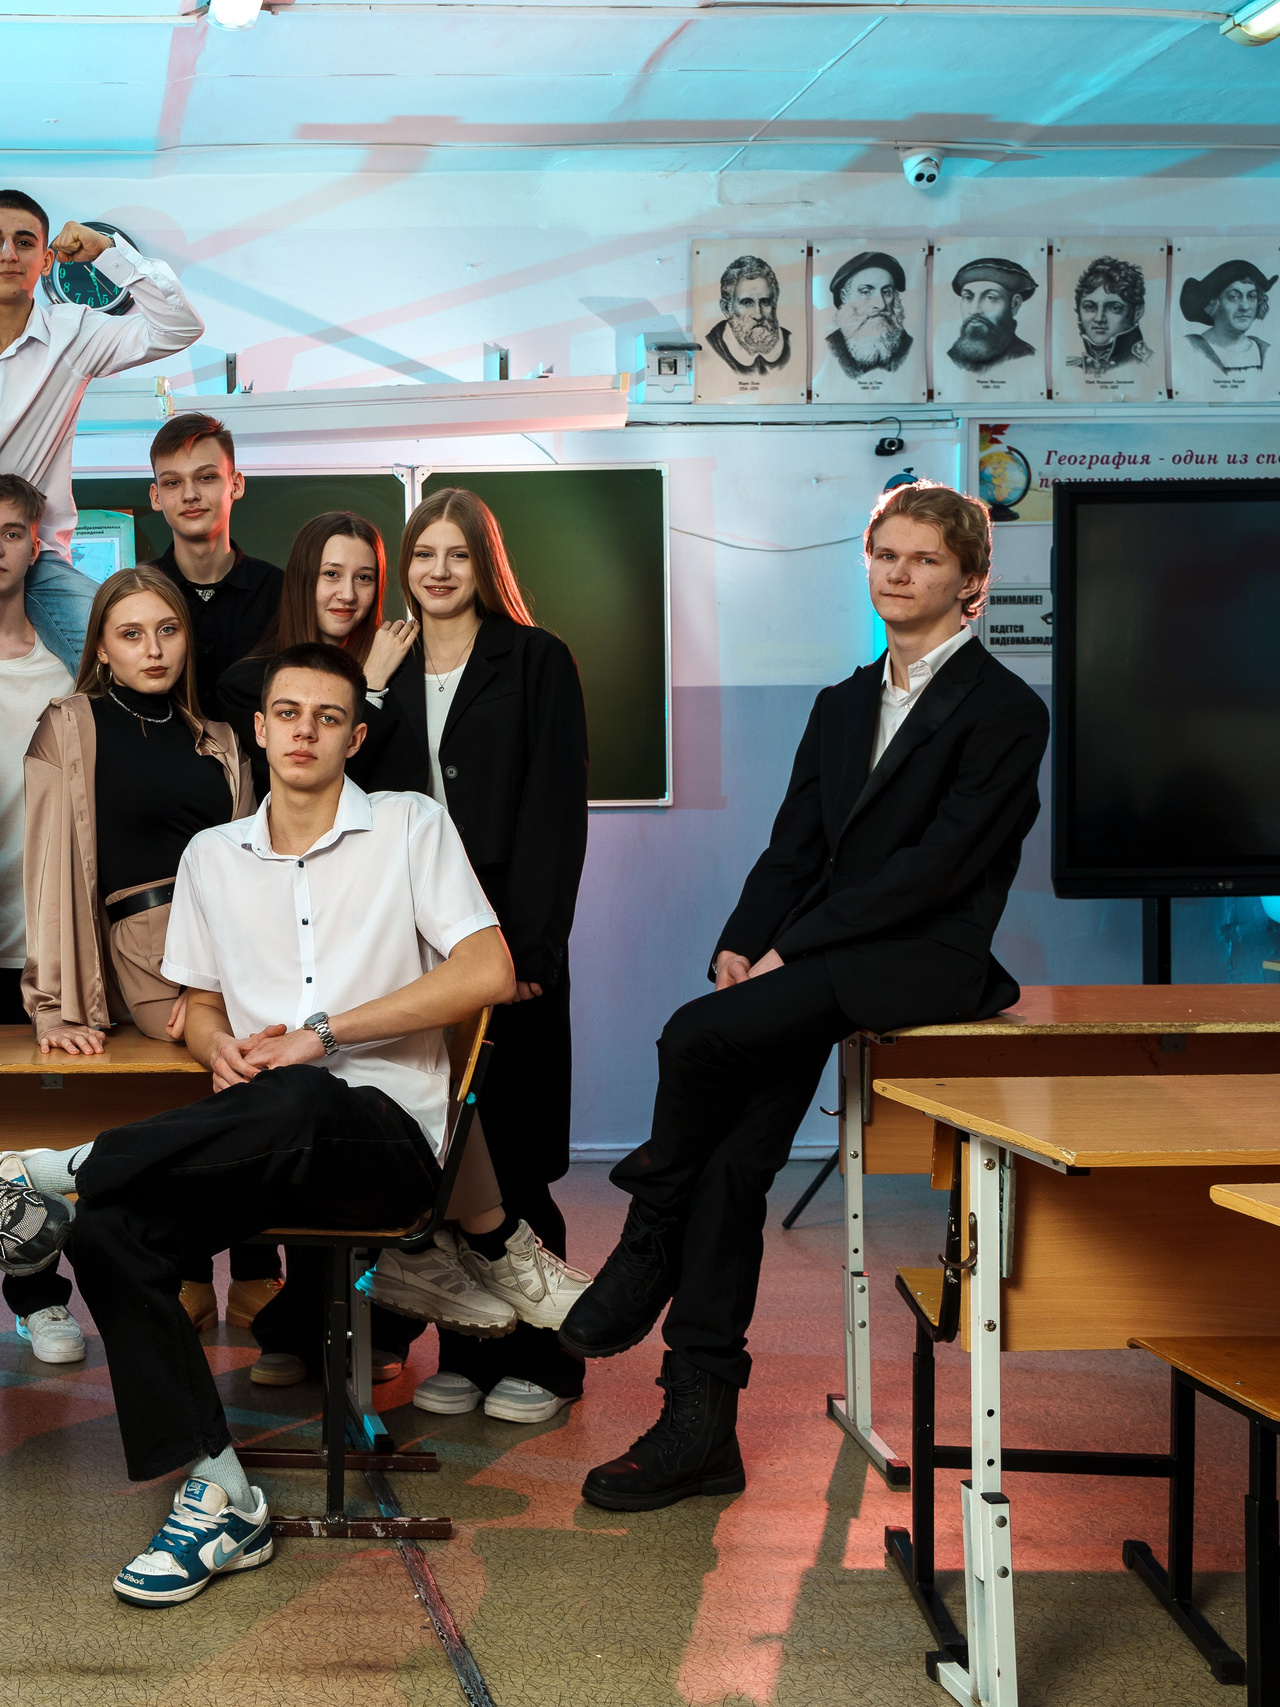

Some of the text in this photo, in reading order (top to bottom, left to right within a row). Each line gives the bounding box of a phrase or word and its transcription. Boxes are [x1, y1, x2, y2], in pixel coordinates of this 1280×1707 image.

[59, 268, 66, 279] 9
[63, 282, 70, 293] 8
[75, 293, 81, 304] 7
[87, 297, 94, 307] 6
[102, 294, 109, 305] 5
[1044, 450, 1151, 470] География
[1172, 449, 1218, 465] один
[1227, 453, 1249, 465] из
[1256, 453, 1280, 465] сп
[990, 595, 1043, 605] ВНИМАНИЕ!
[990, 625, 1024, 635] ВЕДЕТСЯ
